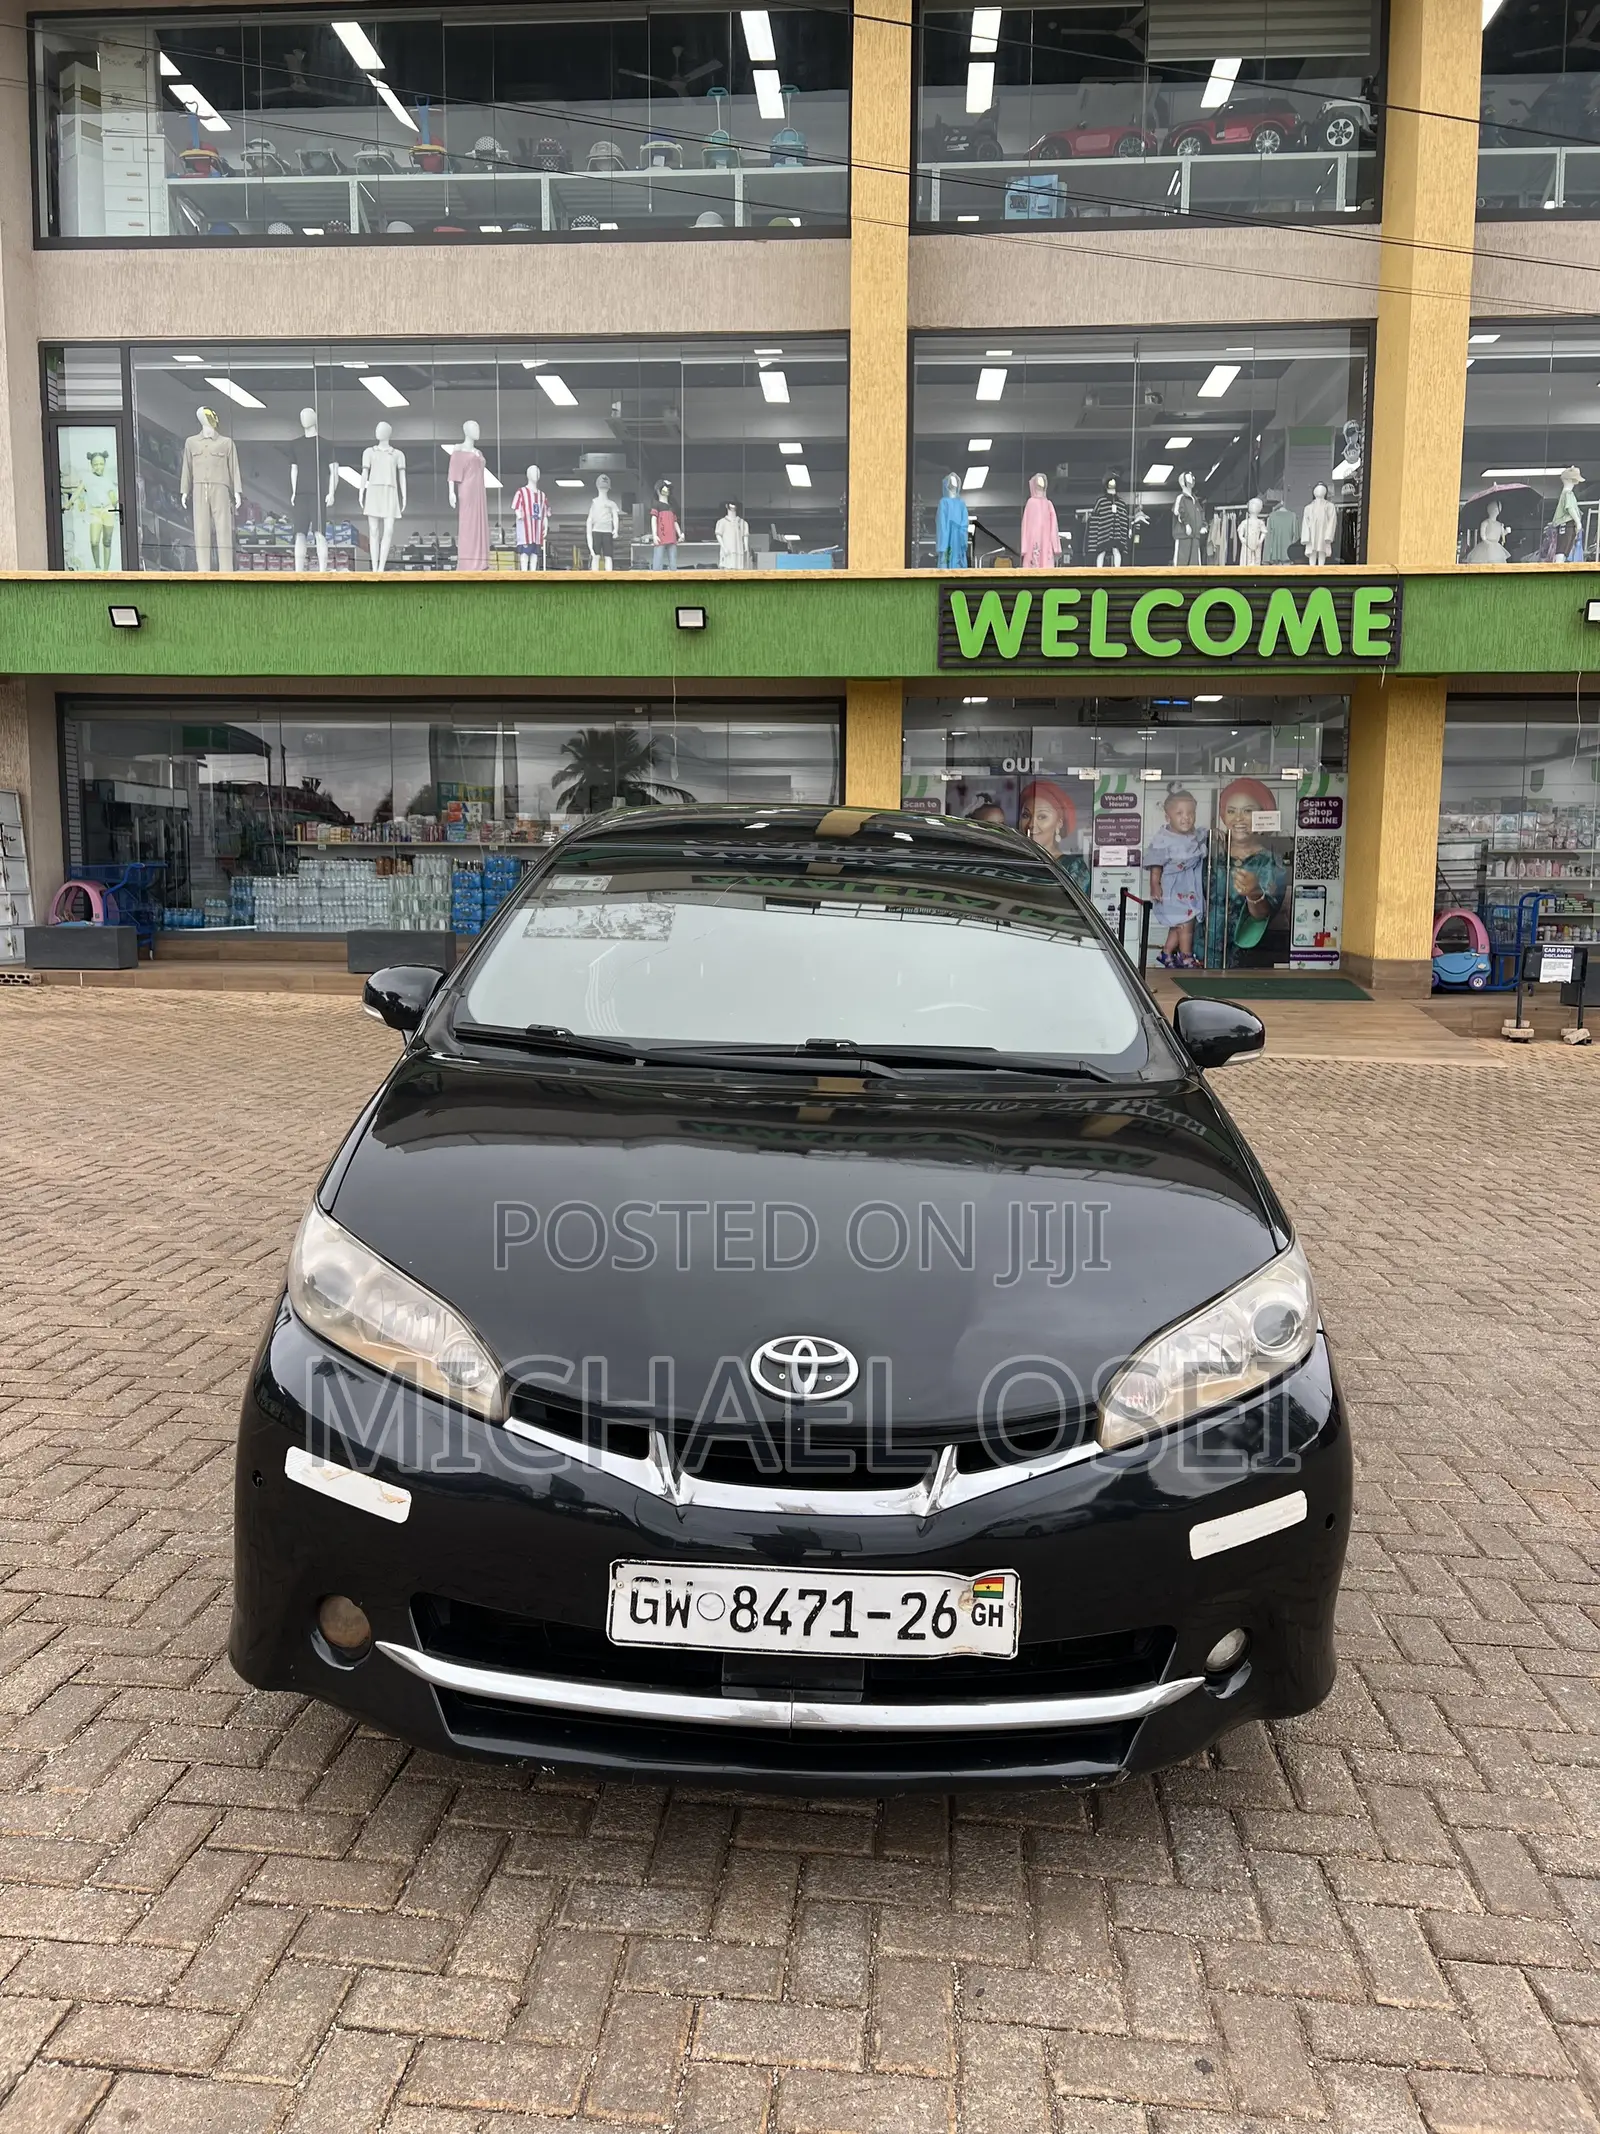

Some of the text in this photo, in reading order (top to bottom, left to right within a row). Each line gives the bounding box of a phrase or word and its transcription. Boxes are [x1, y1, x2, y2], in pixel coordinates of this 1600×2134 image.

[950, 587, 1394, 659] WELCOME
[1002, 757, 1044, 772] OUT
[1214, 757, 1236, 772] IN
[903, 800, 925, 808] Scan
[1303, 799, 1339, 807] Scan to
[1308, 808, 1333, 817] Shop
[1302, 816, 1338, 824] ONLINE
[629, 1576, 1004, 1641] GW 8471-26 GH
